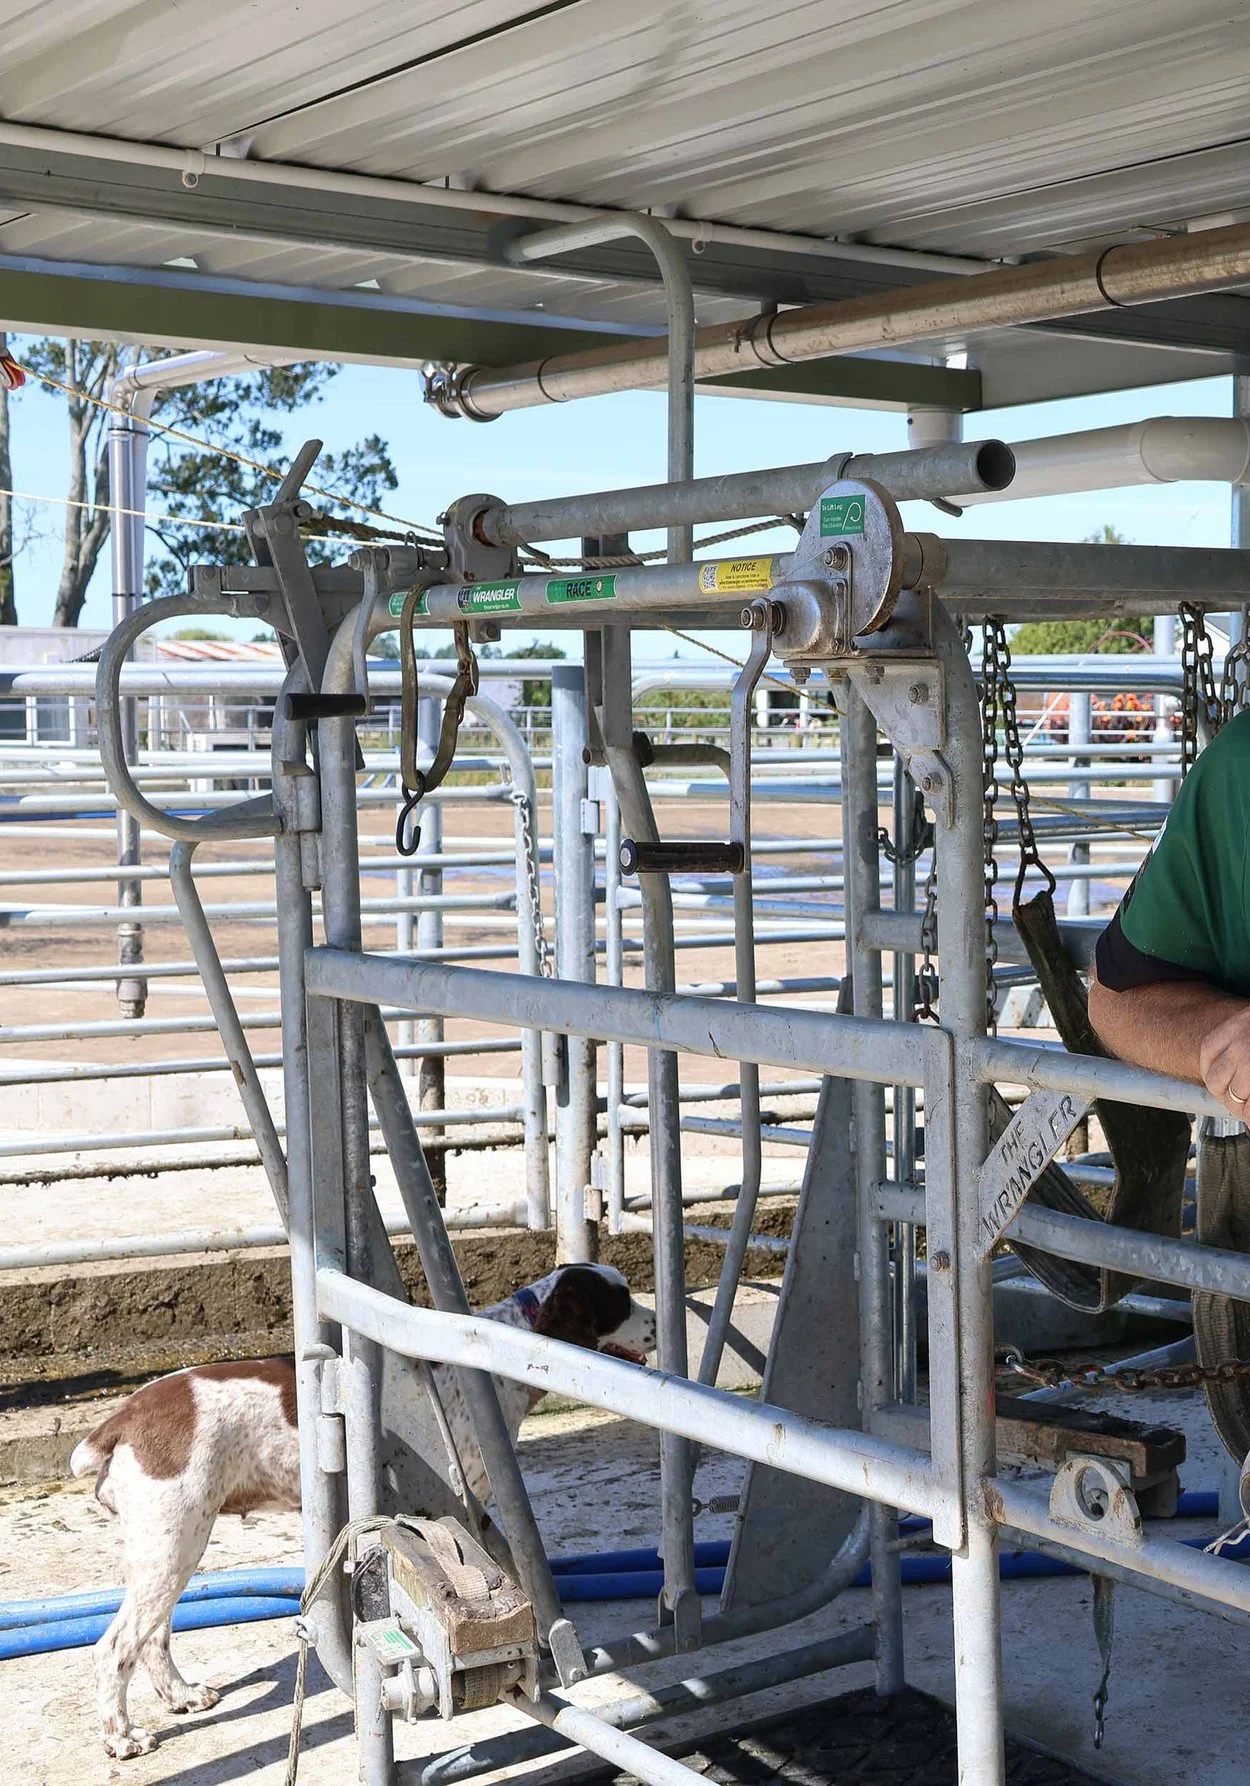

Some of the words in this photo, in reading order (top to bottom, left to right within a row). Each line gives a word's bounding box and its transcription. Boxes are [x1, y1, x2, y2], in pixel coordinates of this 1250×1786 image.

[731, 562, 757, 572] NOTICE
[473, 588, 515, 603] WRANGLER
[566, 581, 592, 598] RACE
[1001, 1121, 1026, 1164] THE
[982, 1096, 1077, 1240] WRANGLER
